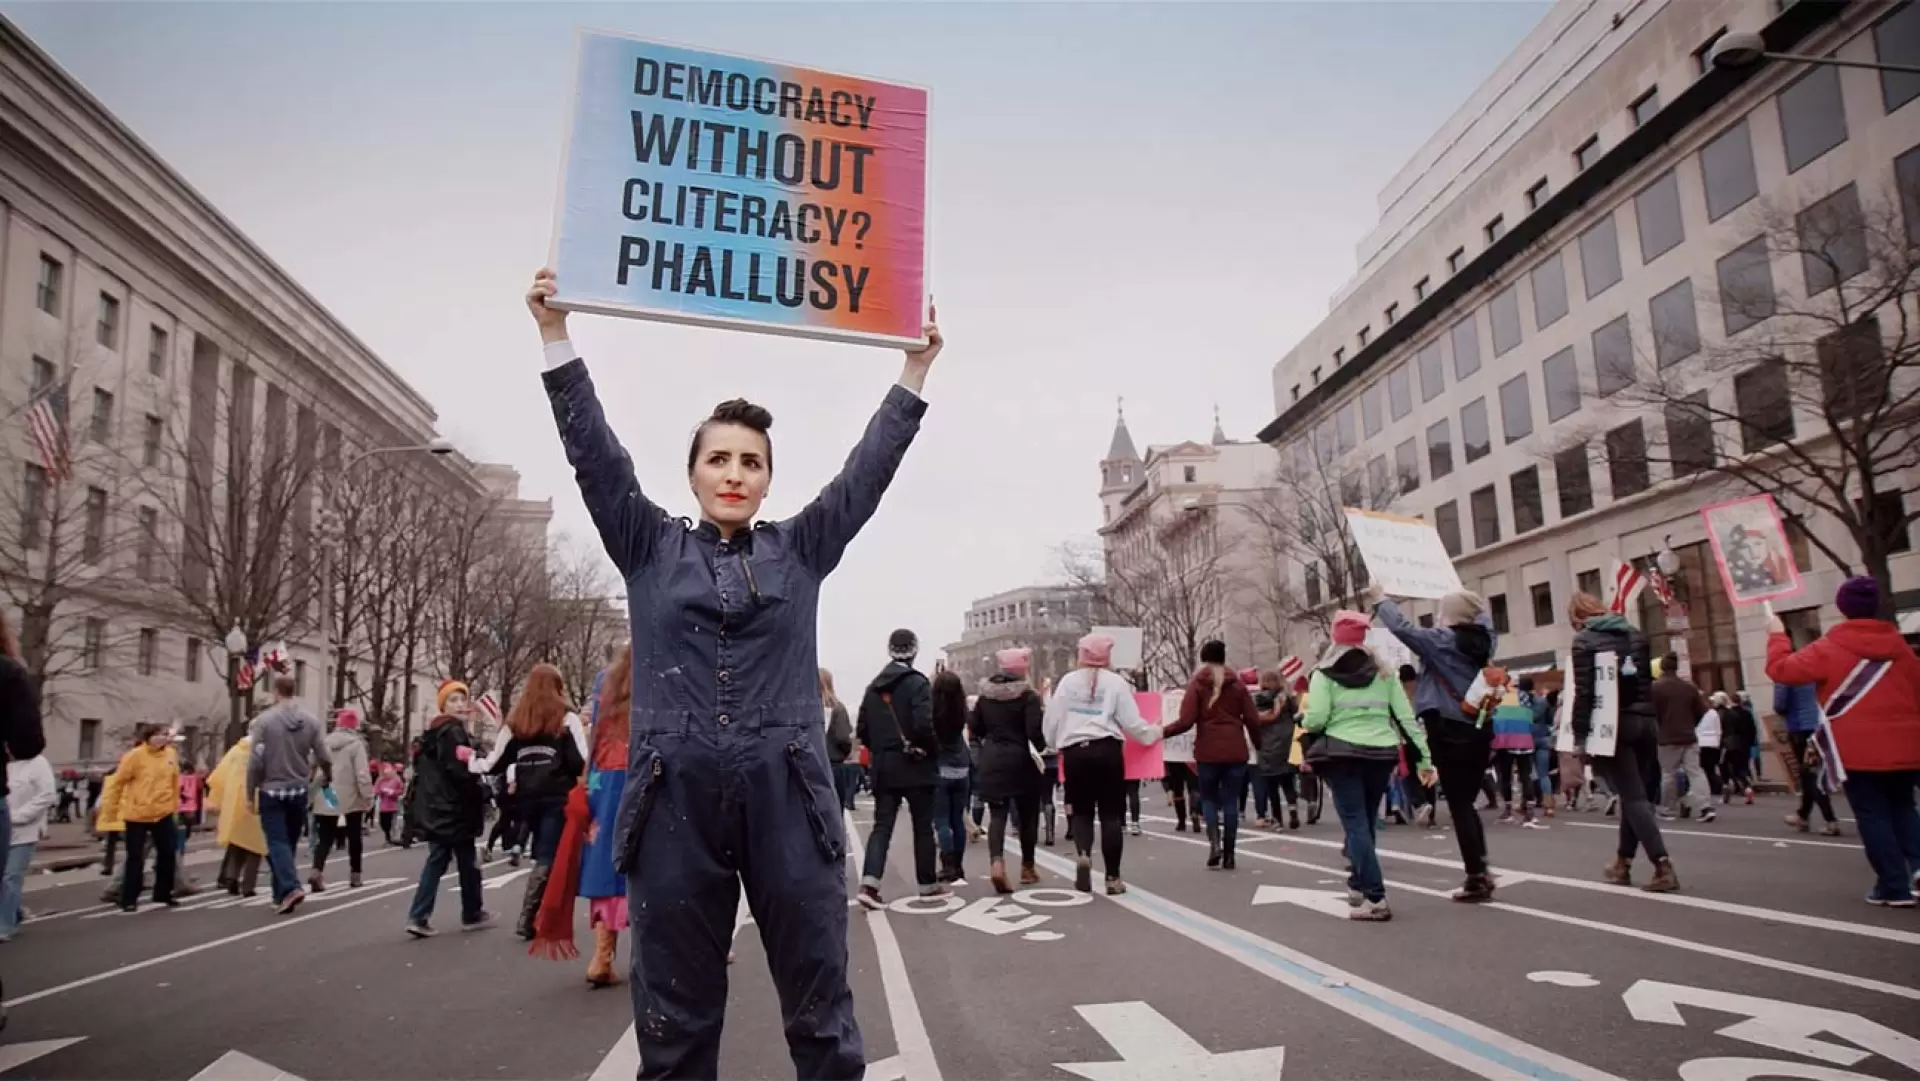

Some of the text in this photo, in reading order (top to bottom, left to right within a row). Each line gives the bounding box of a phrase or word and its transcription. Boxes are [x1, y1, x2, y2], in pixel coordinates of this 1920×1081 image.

[633, 57, 876, 131] DEMOCRACY
[630, 110, 875, 195] WITHOUT
[622, 178, 872, 249] CLITERACY?
[617, 235, 870, 314] PHALLUSY
